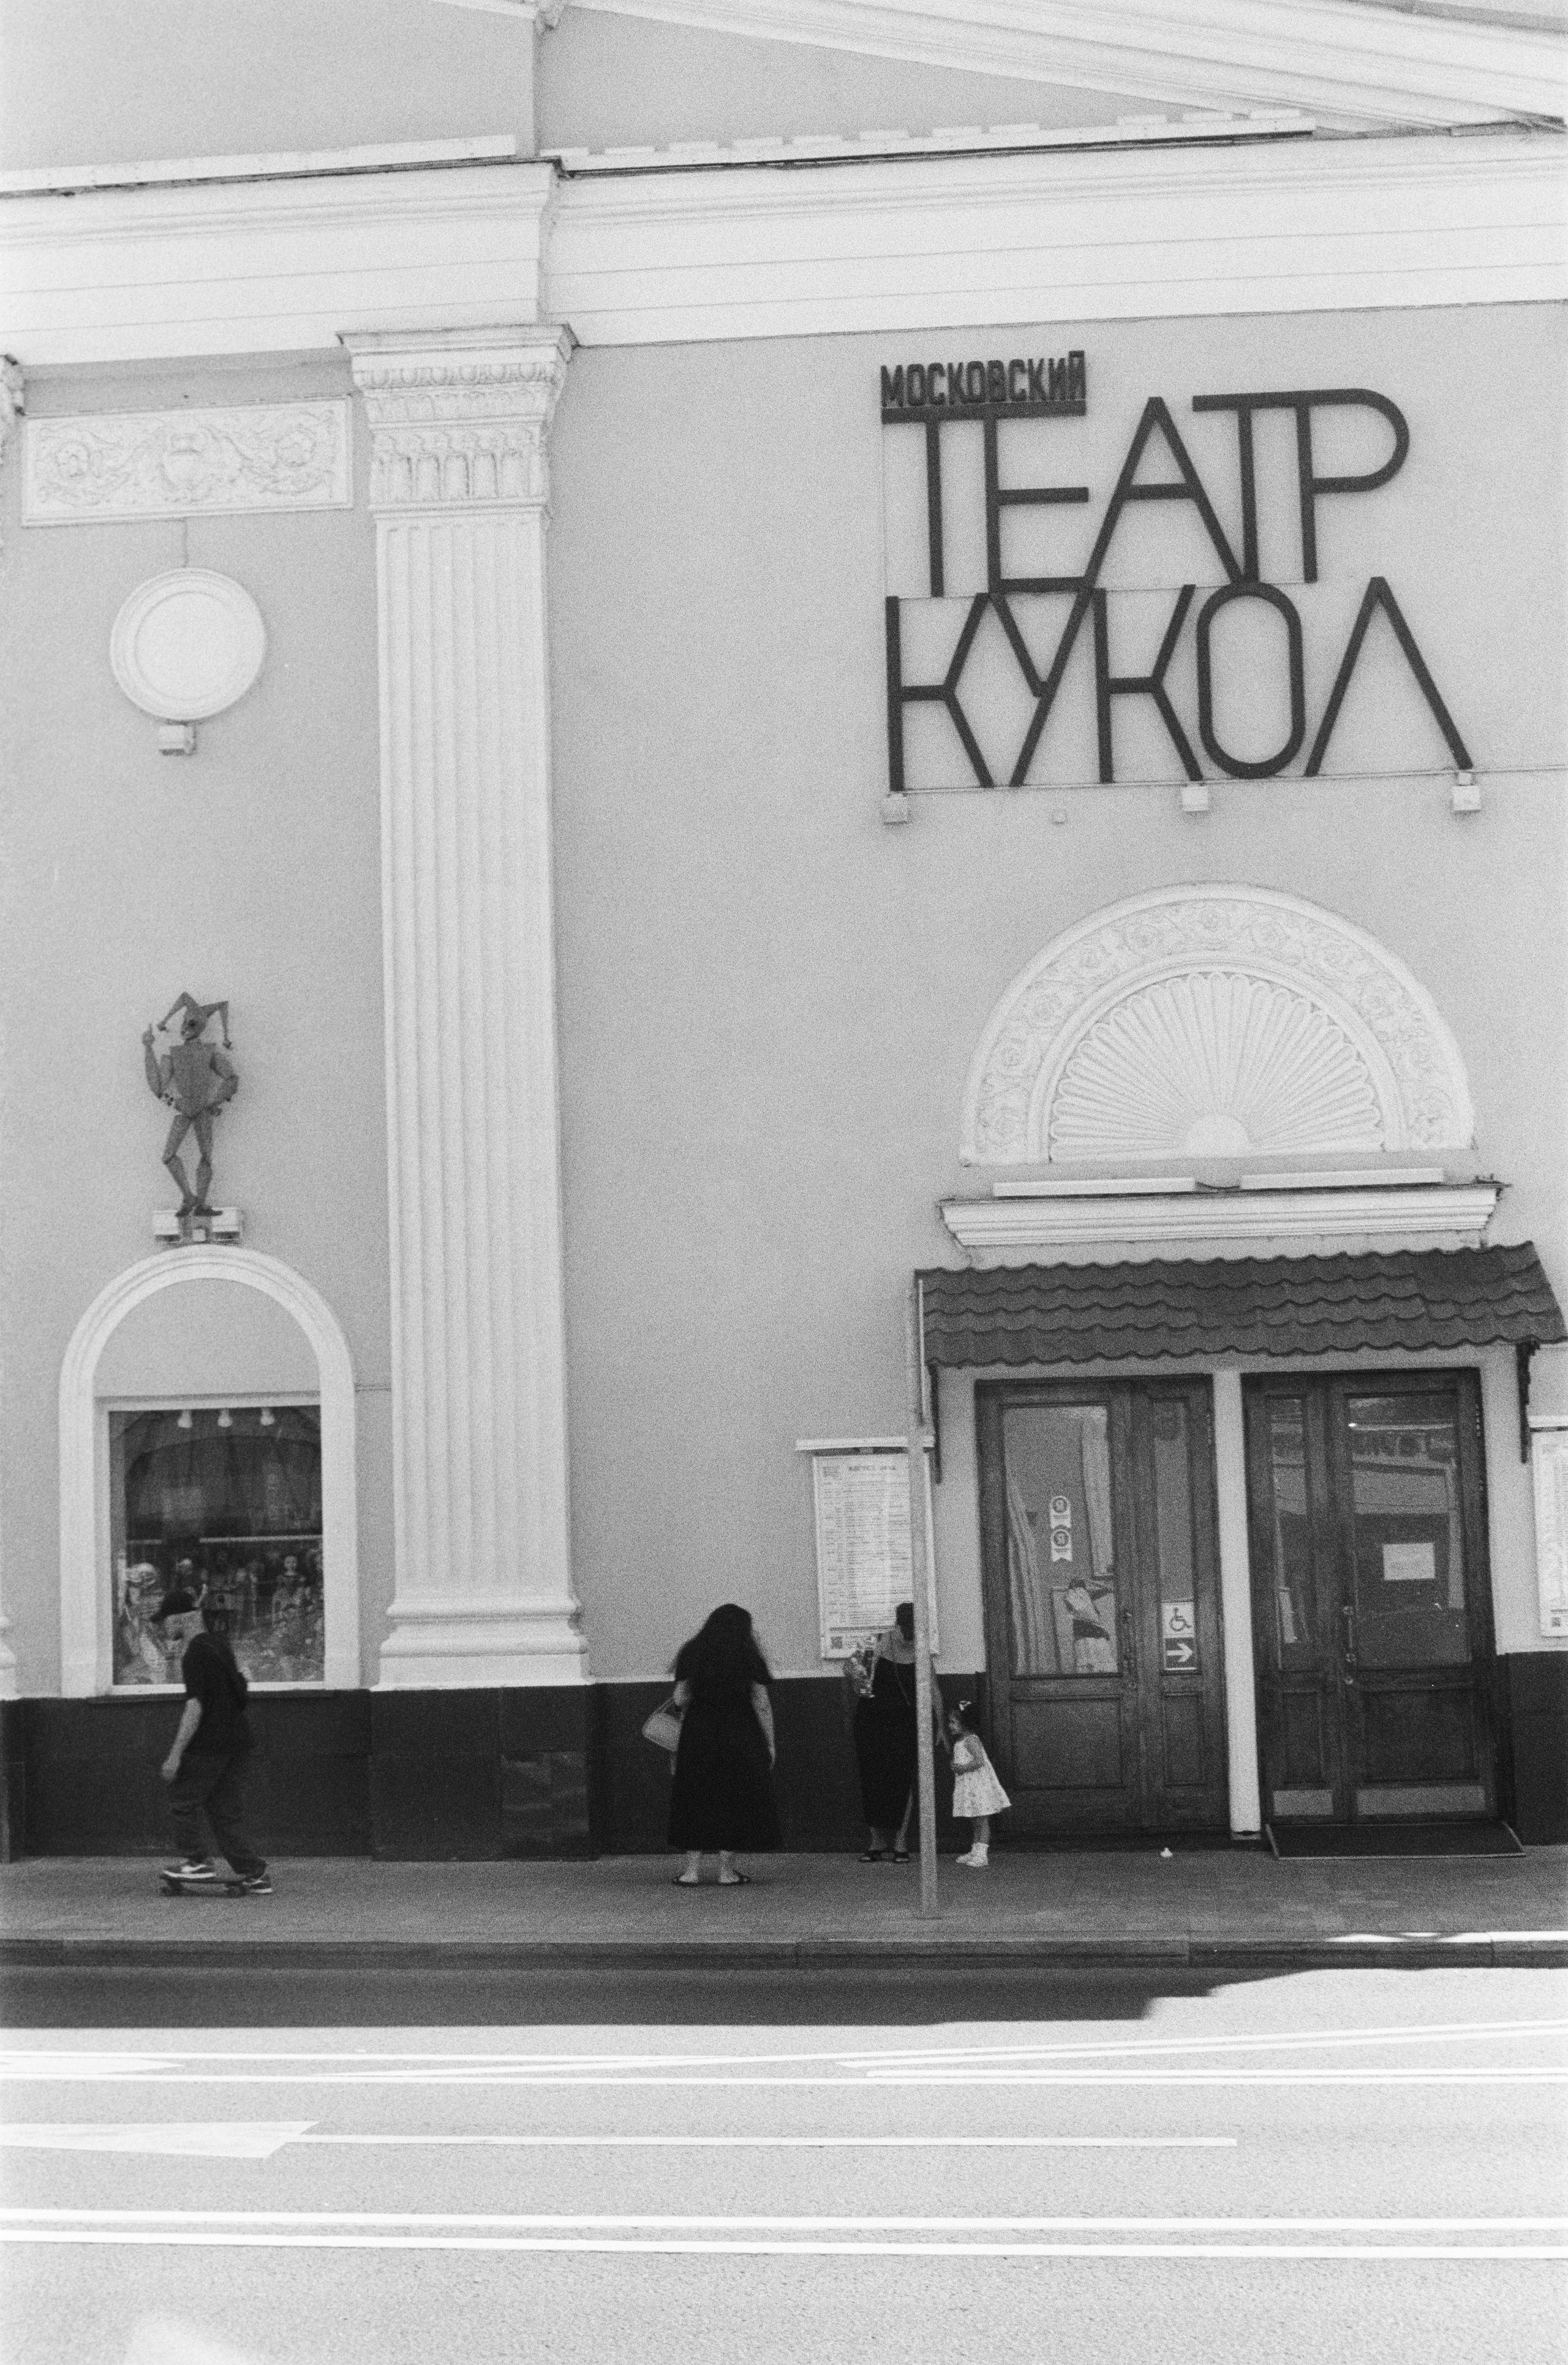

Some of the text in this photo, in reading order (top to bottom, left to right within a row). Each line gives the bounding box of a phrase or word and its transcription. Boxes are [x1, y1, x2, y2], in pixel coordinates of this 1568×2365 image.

[880, 350, 1087, 407] МОСКОВСКИЙ
[881, 387, 1411, 598] ТЕАТР
[885, 575, 1473, 791] КУКОЛ
